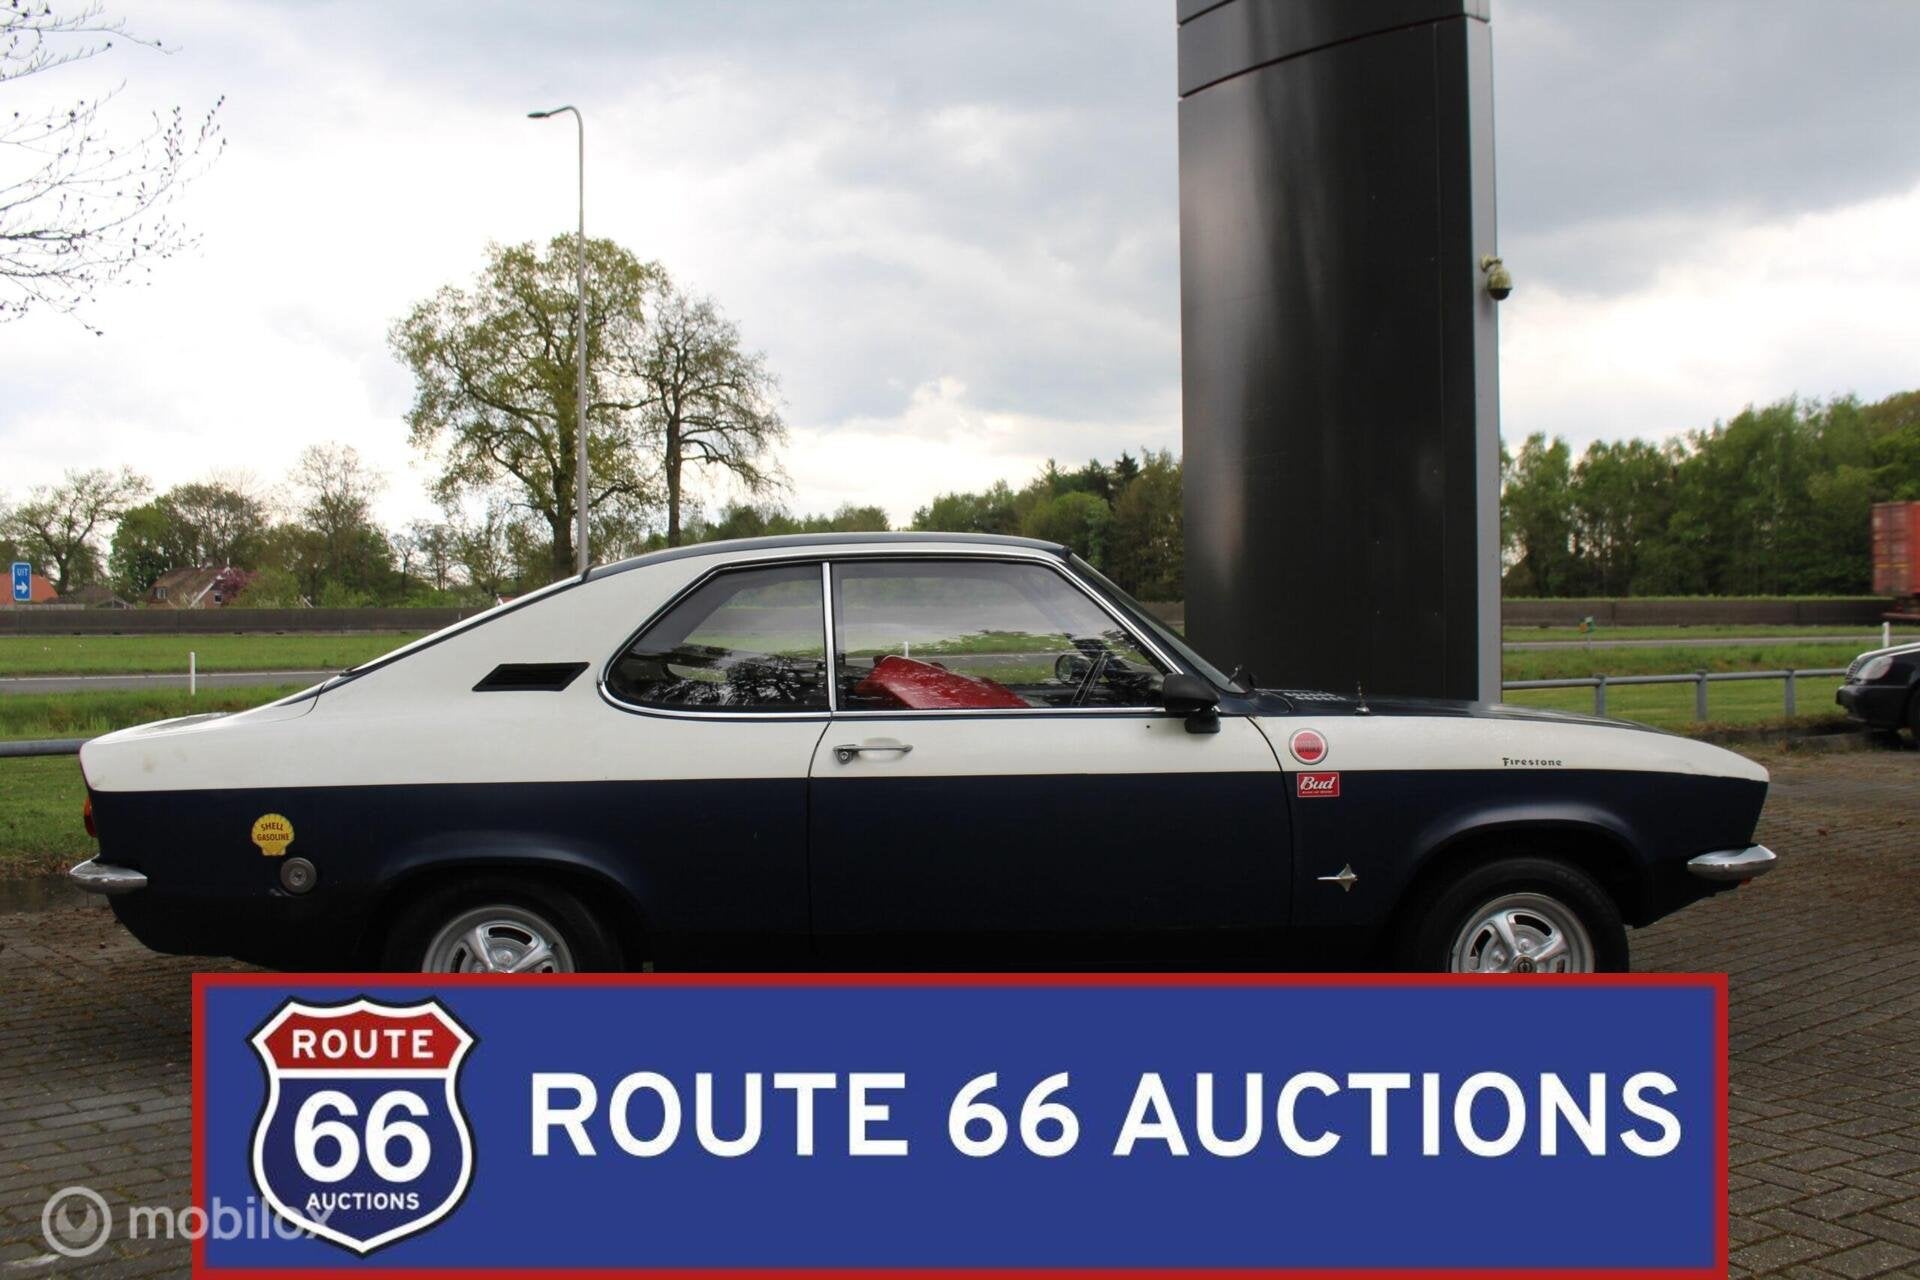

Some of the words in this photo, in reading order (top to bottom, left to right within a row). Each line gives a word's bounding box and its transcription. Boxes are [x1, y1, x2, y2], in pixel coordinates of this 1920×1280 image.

[16, 567, 28, 577] UIT
[1502, 757, 1562, 767] Firestone
[1300, 776, 1336, 791] Bud
[261, 822, 283, 832] SHELL
[257, 833, 290, 841] GASOLINE
